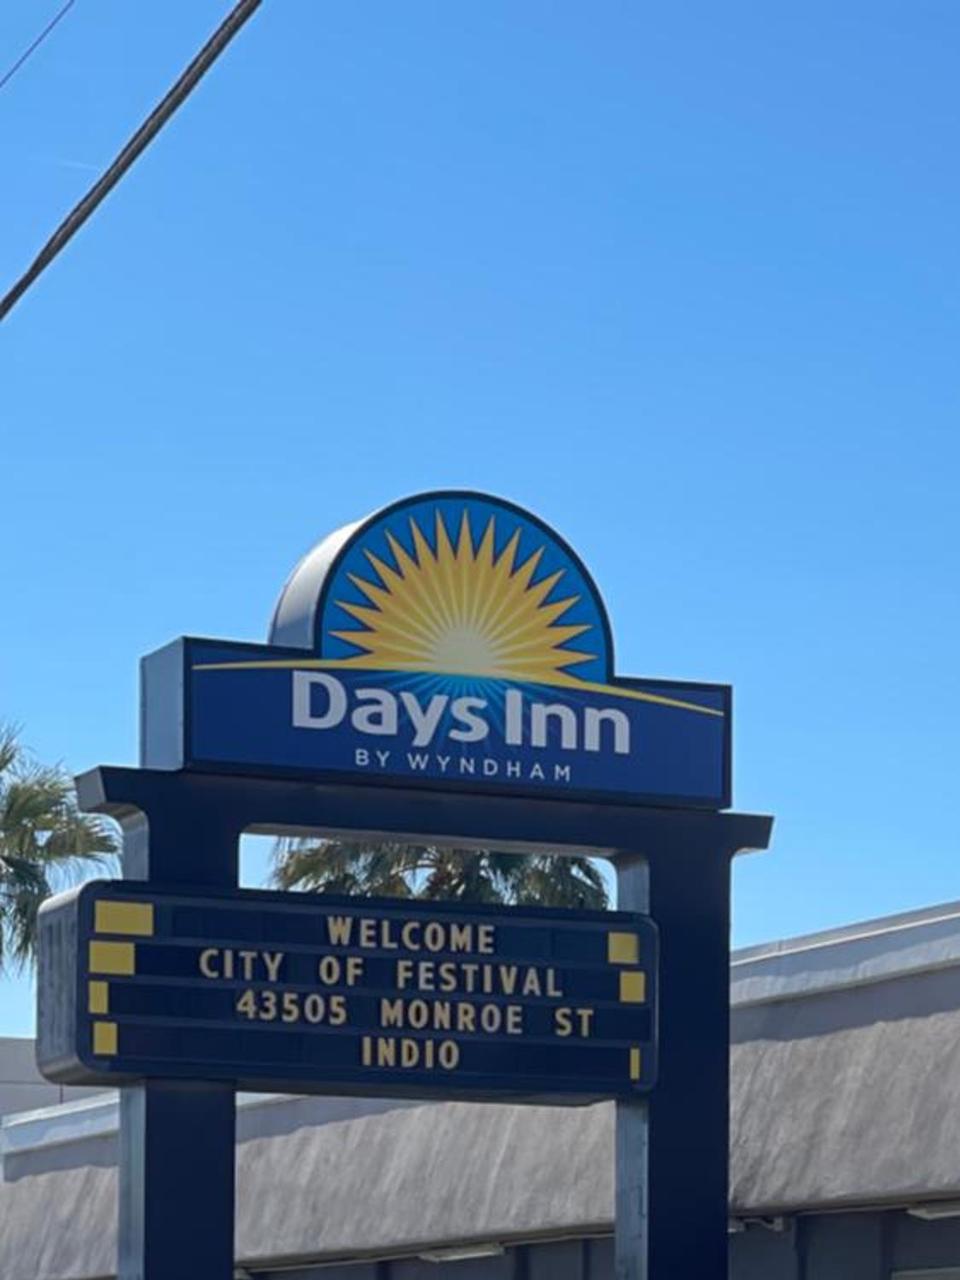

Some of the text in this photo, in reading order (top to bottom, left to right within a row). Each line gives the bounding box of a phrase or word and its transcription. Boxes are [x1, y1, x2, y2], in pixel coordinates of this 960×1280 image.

[292, 669, 631, 753] Days Inn
[354, 749, 572, 782] BY WYNDHAM
[327, 915, 495, 952] WELCOME
[199, 949, 563, 997] CITY OF FESTIVAL
[236, 992, 593, 1037] 43505 MONROE ST
[362, 1037, 460, 1070] INDIO
